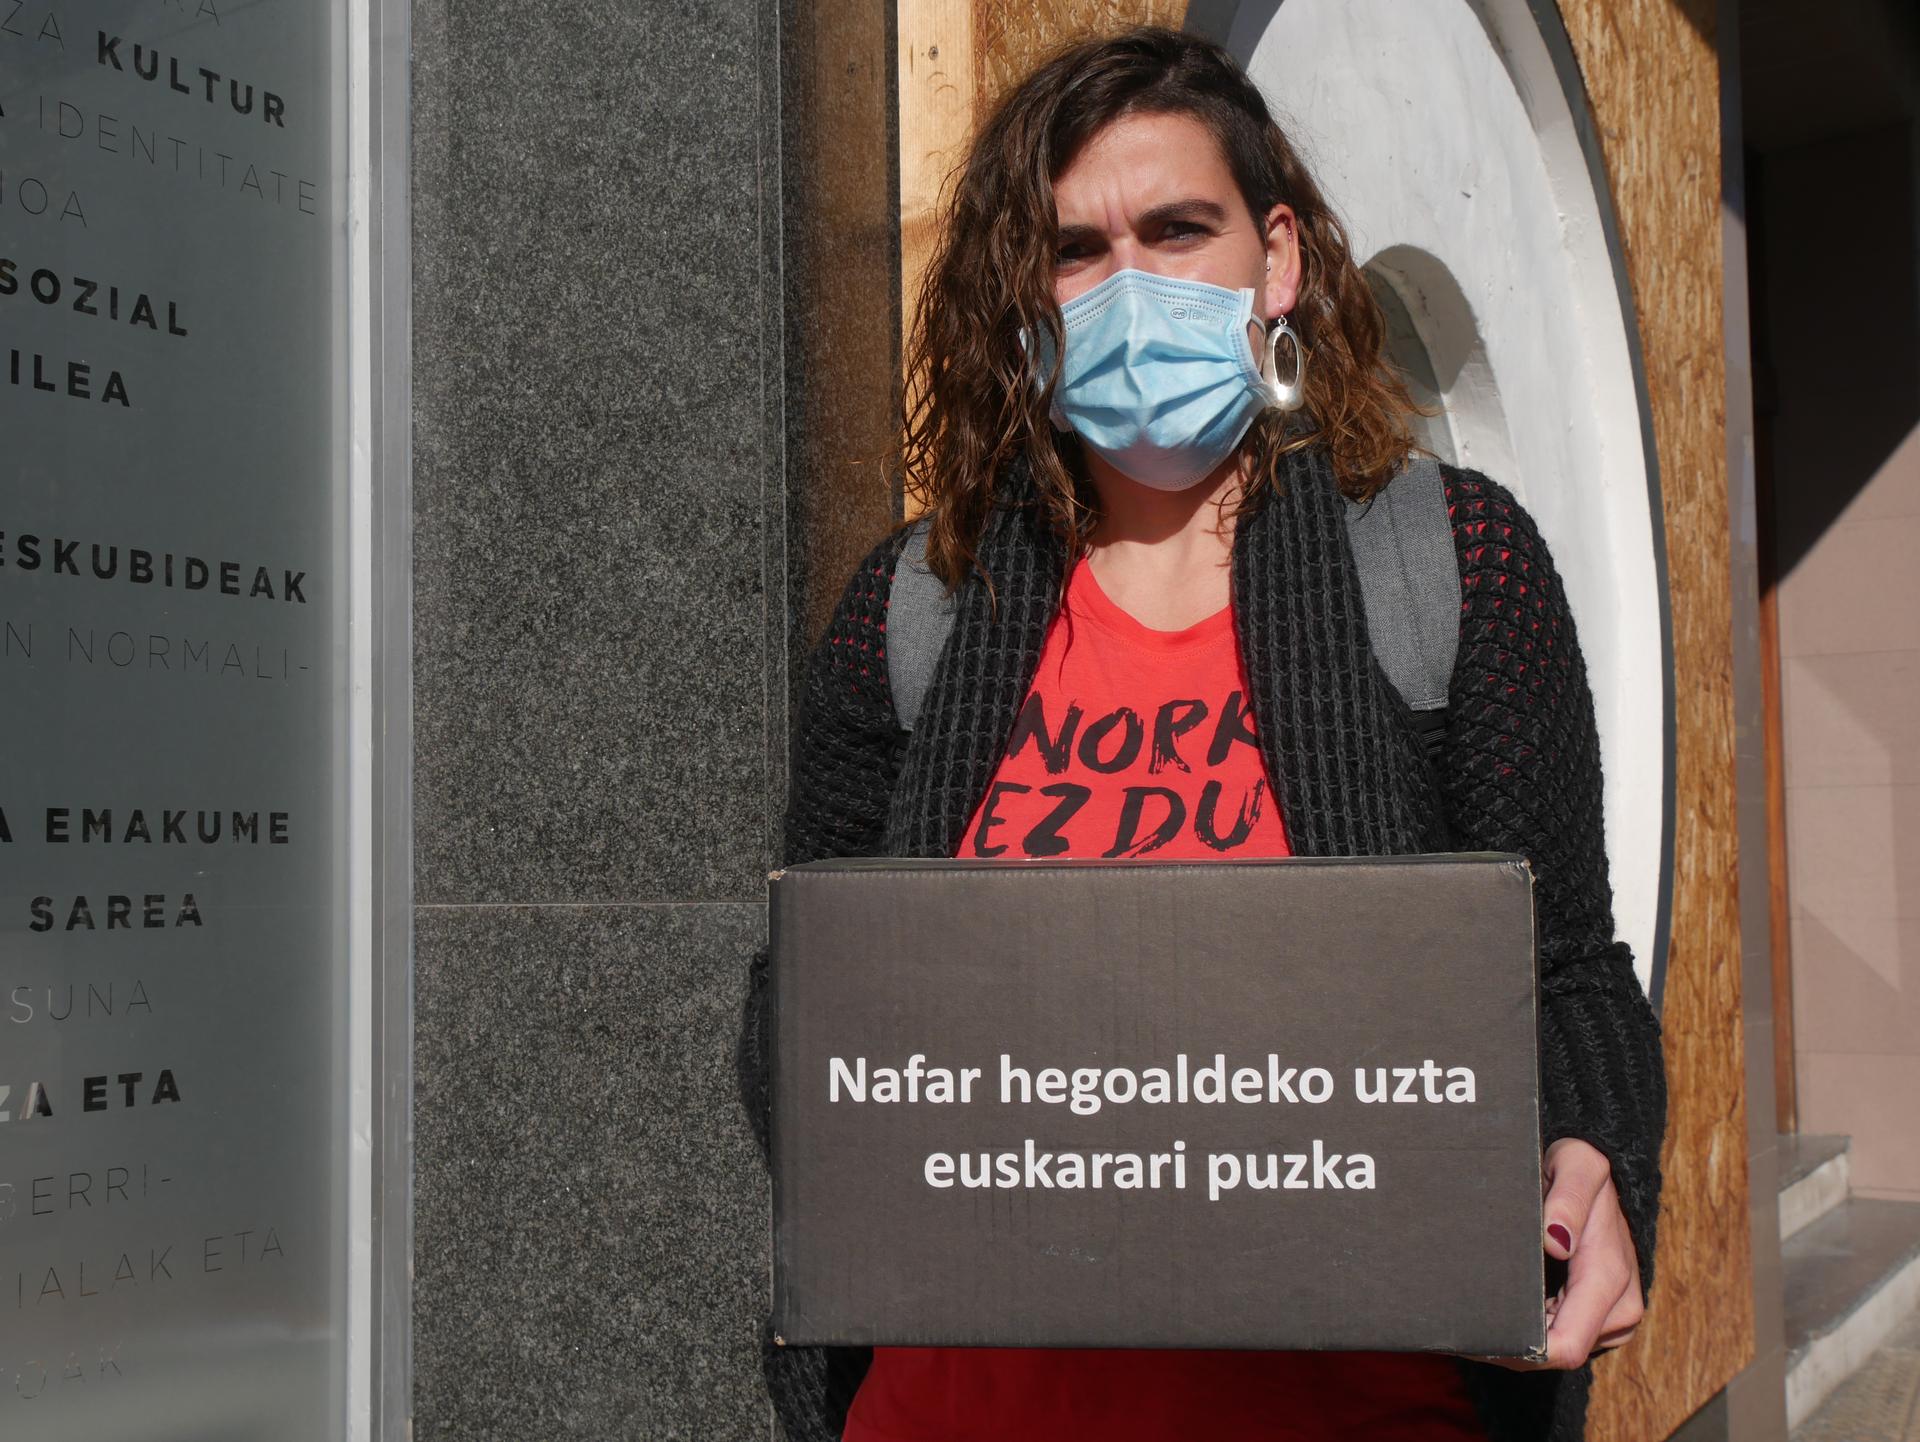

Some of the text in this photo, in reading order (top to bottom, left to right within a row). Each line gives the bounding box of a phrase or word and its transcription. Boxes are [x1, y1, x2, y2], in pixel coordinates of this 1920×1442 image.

[97, 30, 286, 128] KULTUR
[39, 95, 316, 215] IDENTITATE
[0, 258, 189, 337] SOZIAL
[10, 349, 131, 408] ILEA
[0, 531, 307, 604] SKUBIDEAK
[69, 626, 310, 681] NORMALI-
[46, 808, 289, 844] EMAKUME
[973, 777, 1265, 858] EZ DU
[29, 893, 203, 932] SAREA
[9, 979, 153, 1024] SUNA
[83, 1068, 182, 1112] ETA
[829, 1054, 1476, 1115] Nafar hegoaldeko uzta
[924, 1139, 1376, 1201] euskarari puzka
[203, 1226, 285, 1274] ETA
